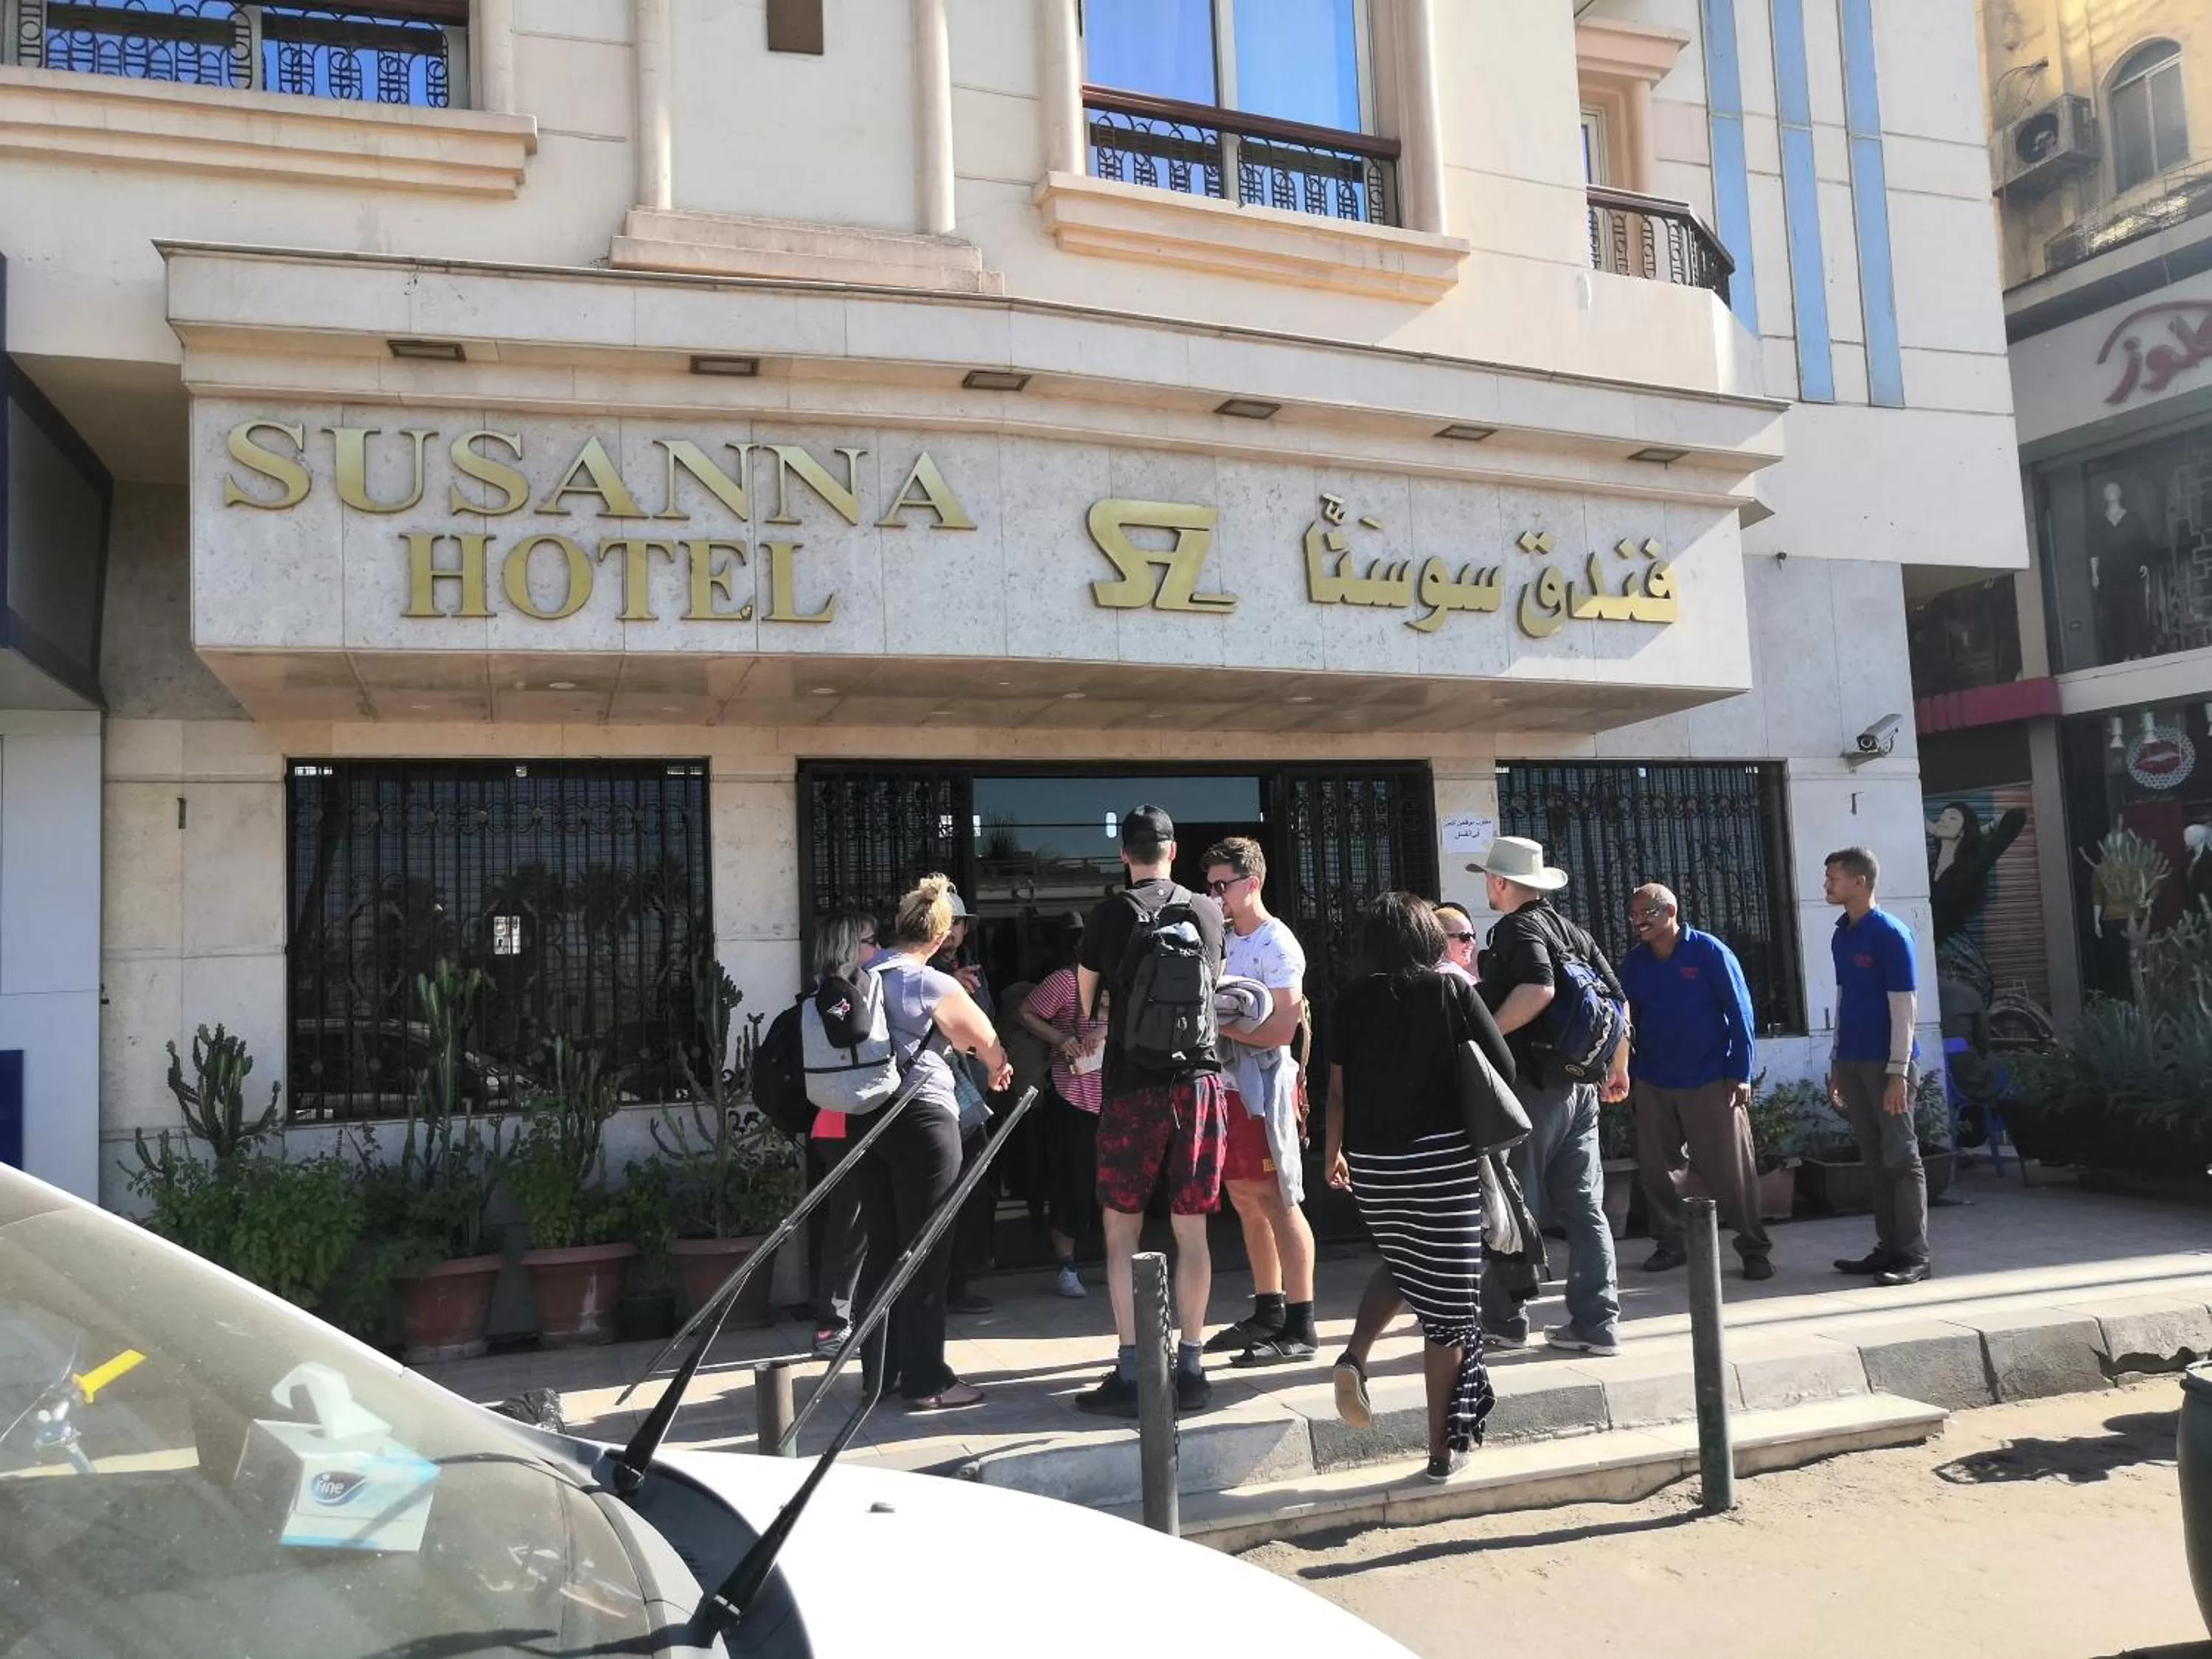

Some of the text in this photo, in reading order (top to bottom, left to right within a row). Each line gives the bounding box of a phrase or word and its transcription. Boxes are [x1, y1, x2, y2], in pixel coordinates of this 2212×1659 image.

[223, 419, 978, 530] SUSANNA
[400, 532, 836, 623] HOTEL
[1516, 530, 1677, 639] فندق
